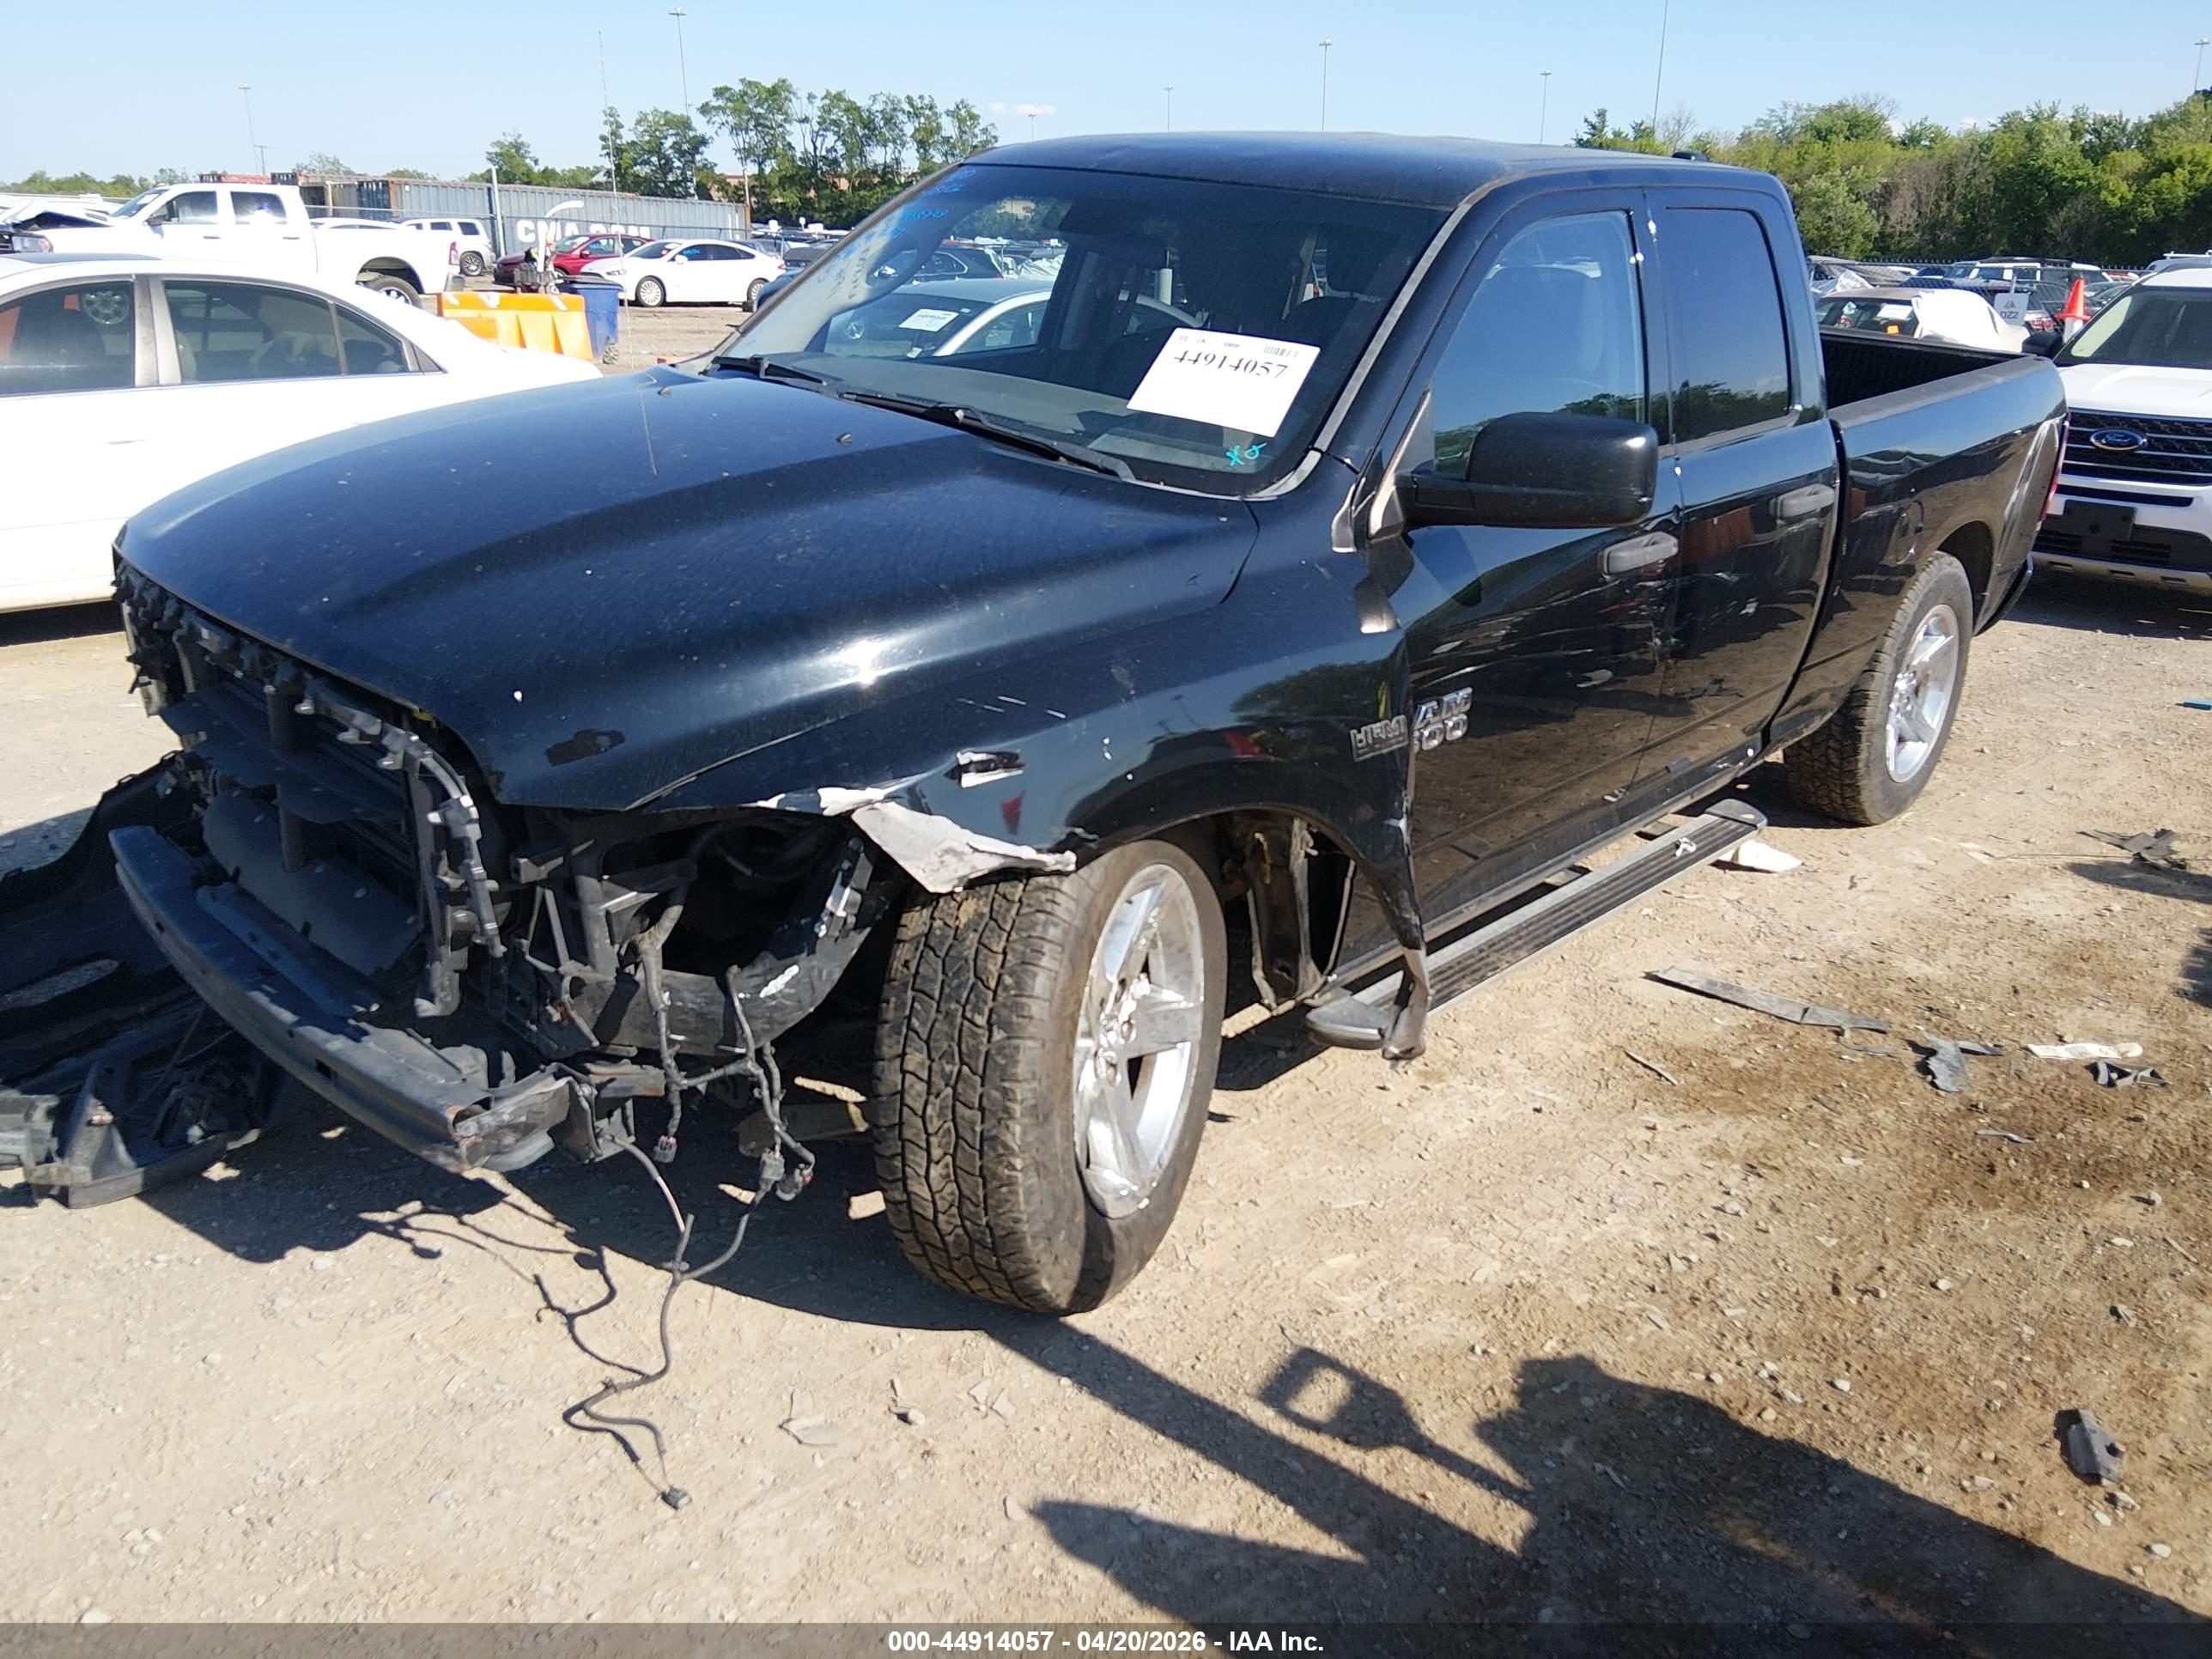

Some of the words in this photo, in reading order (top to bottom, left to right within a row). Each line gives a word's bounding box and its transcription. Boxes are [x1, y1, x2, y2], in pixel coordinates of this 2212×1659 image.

[517, 220, 579, 243] CMA
[1174, 350, 1288, 378] 44914057
[1414, 687, 1473, 729] AM
